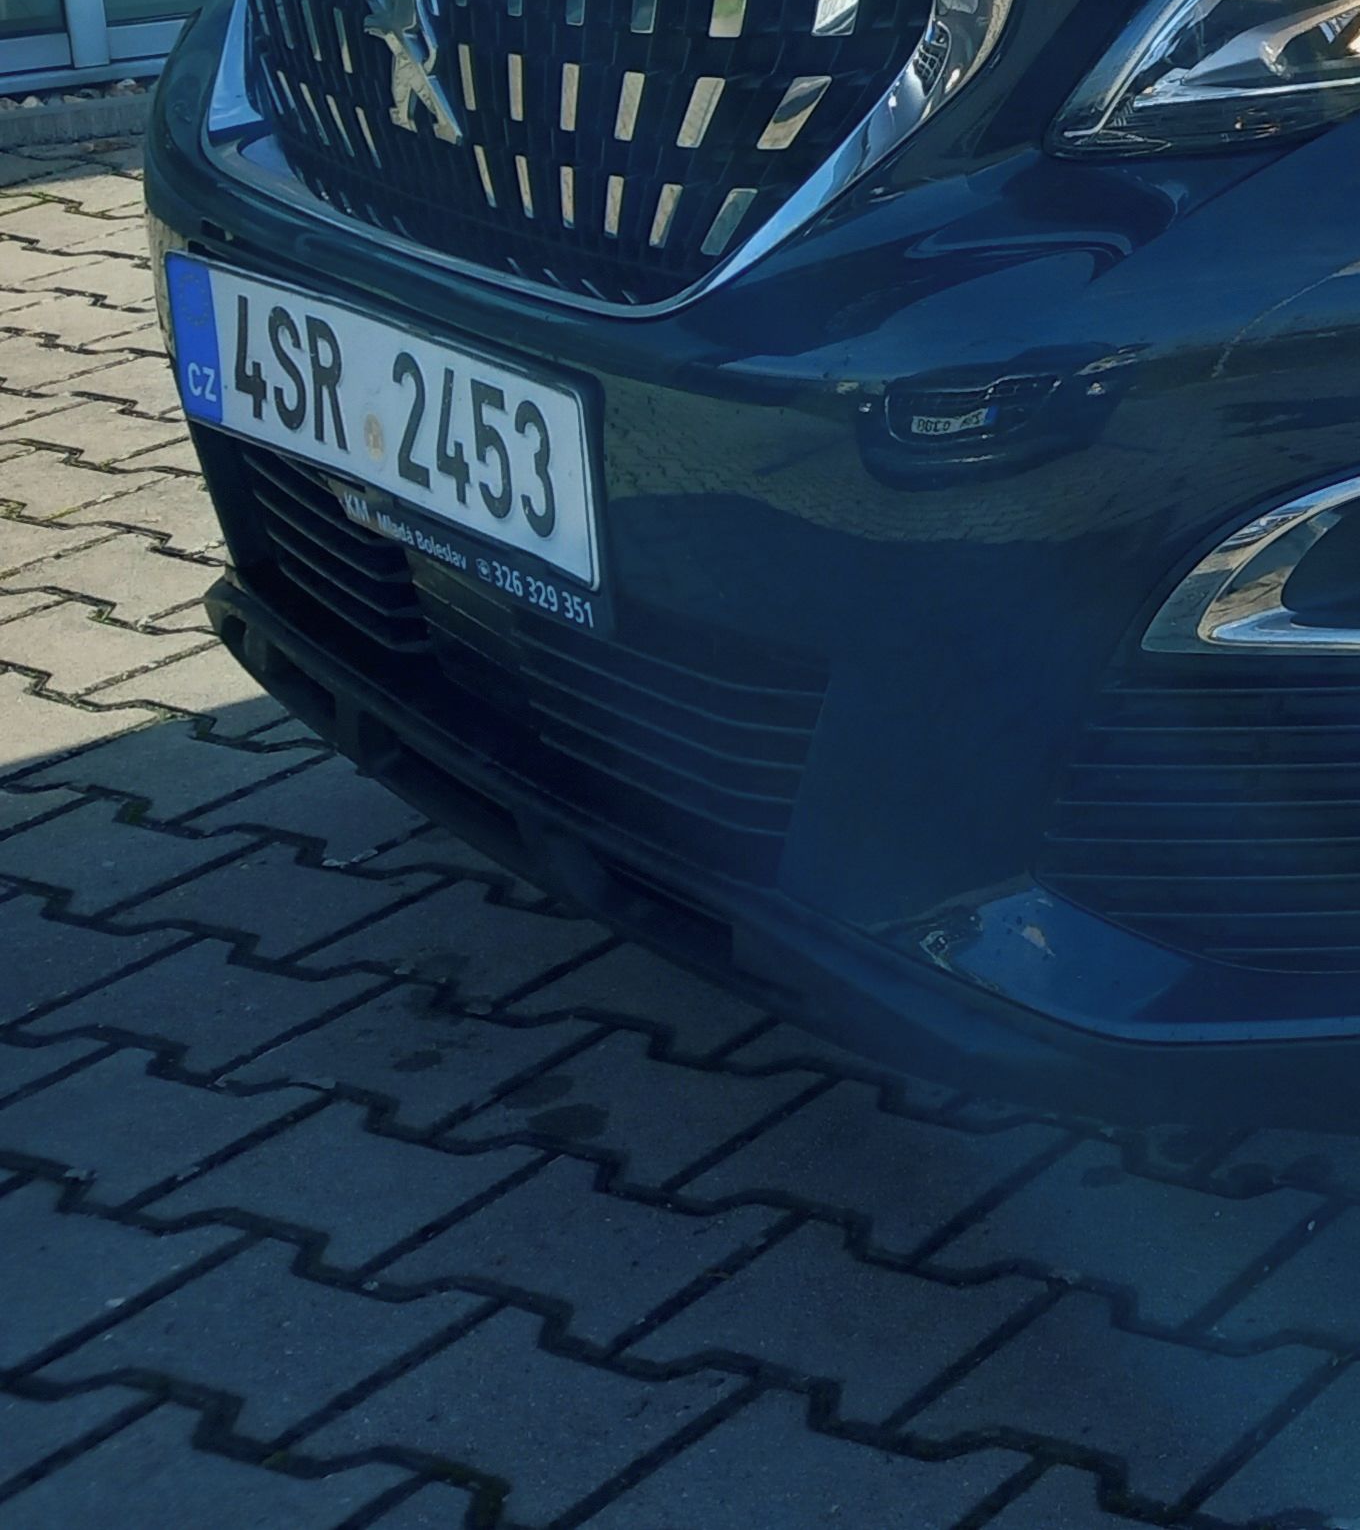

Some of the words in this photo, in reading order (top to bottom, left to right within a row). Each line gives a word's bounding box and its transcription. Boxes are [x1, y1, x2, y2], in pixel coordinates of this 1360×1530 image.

[187, 361, 217, 402] CZ
[234, 294, 351, 455] 4SR
[392, 351, 557, 539] 2453
[416, 530, 467, 570] Boleslav
[492, 561, 524, 597] 326
[527, 576, 558, 612] 329
[562, 591, 594, 628] 351
